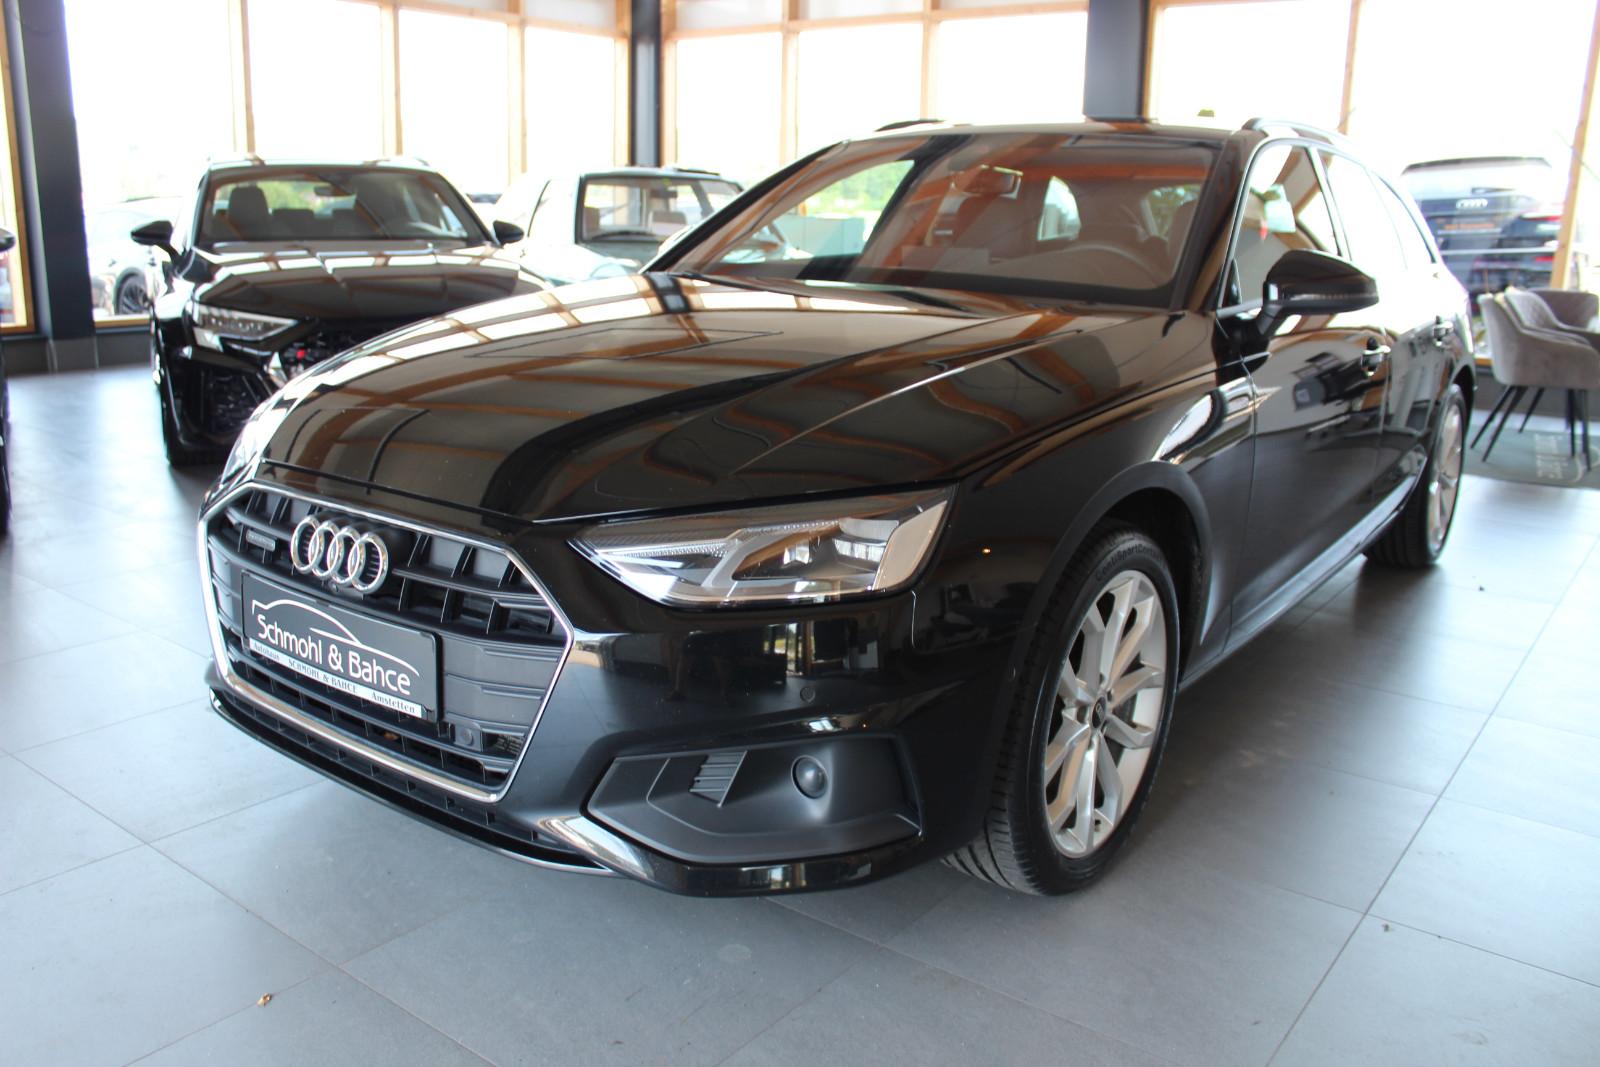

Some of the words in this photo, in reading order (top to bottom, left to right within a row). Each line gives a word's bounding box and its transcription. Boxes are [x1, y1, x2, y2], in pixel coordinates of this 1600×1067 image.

[257, 613, 323, 665] Schmohl
[327, 644, 344, 673] &
[348, 651, 411, 696] Bahce
[322, 674, 331, 683] &
[371, 691, 416, 714] Amstetten
